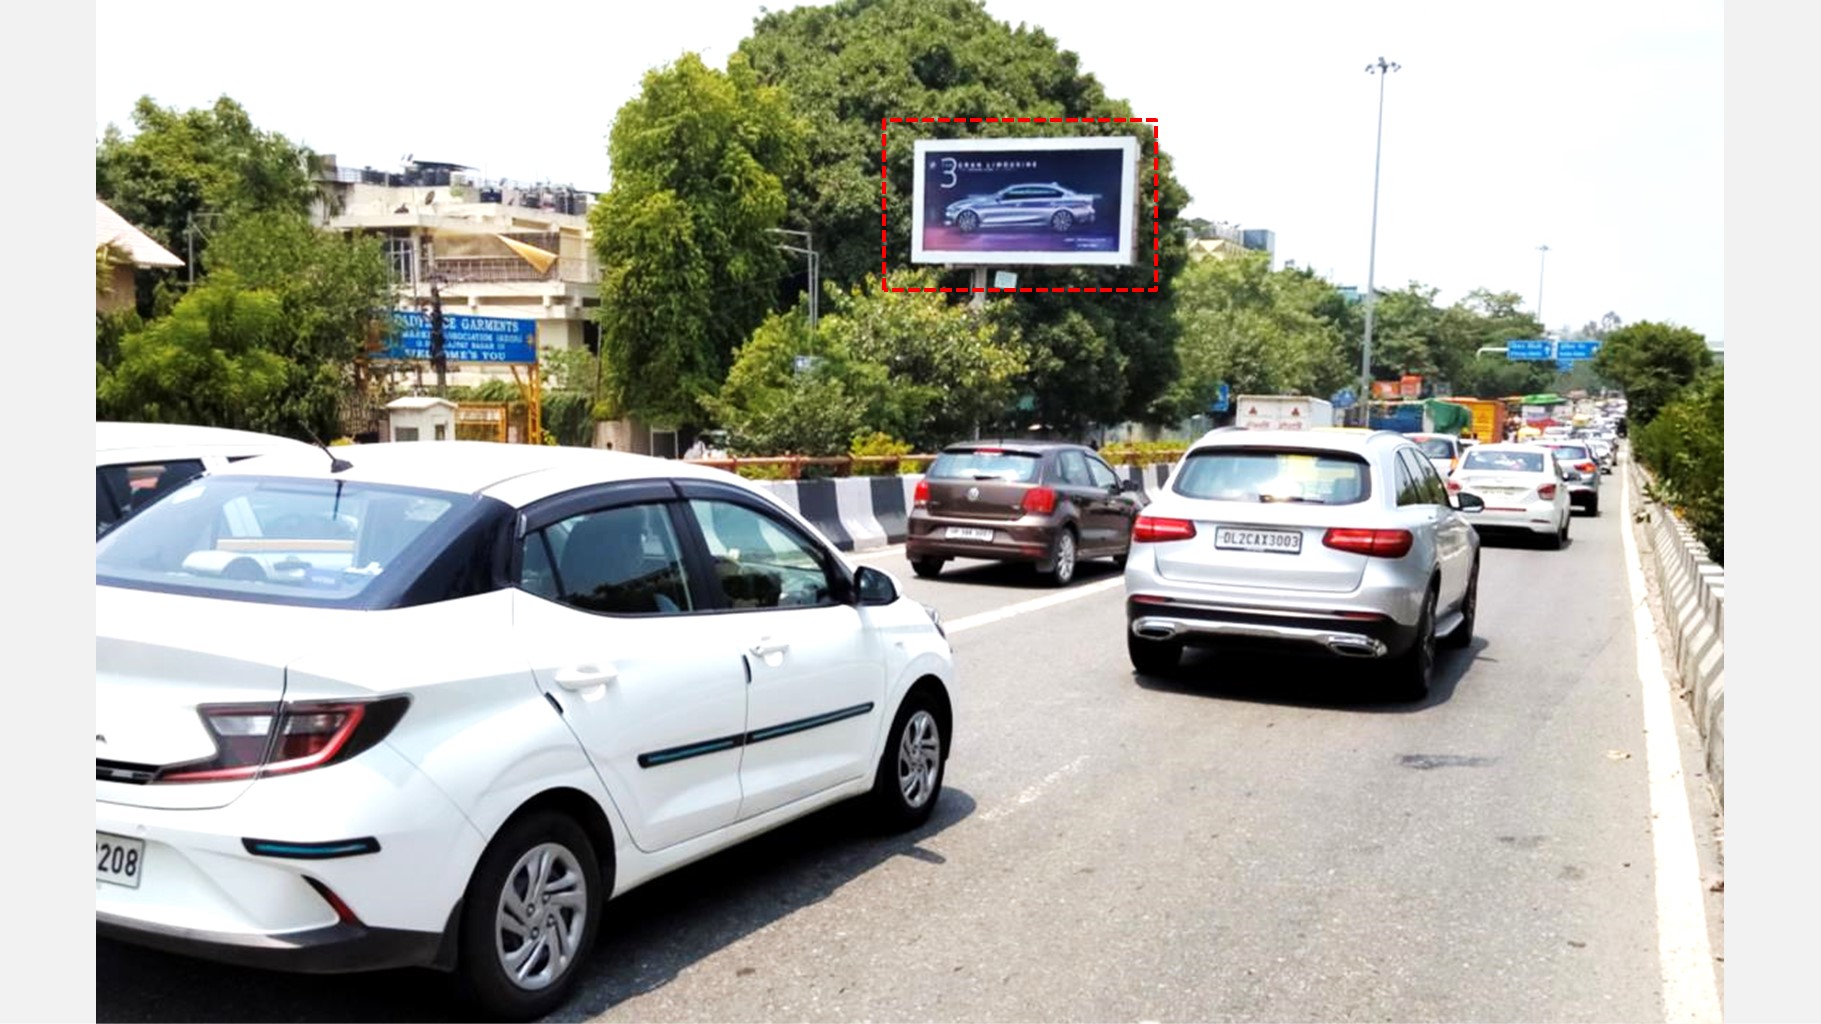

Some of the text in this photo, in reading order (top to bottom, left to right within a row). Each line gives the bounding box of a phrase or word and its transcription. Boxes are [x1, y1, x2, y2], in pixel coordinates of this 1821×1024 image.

[941, 157, 957, 188] 3
[461, 318, 519, 332] GARMENTS
[404, 348, 506, 360] WELME'S YOU
[1223, 531, 1299, 548] DL2CAX3003
[96, 843, 139, 877] 208
